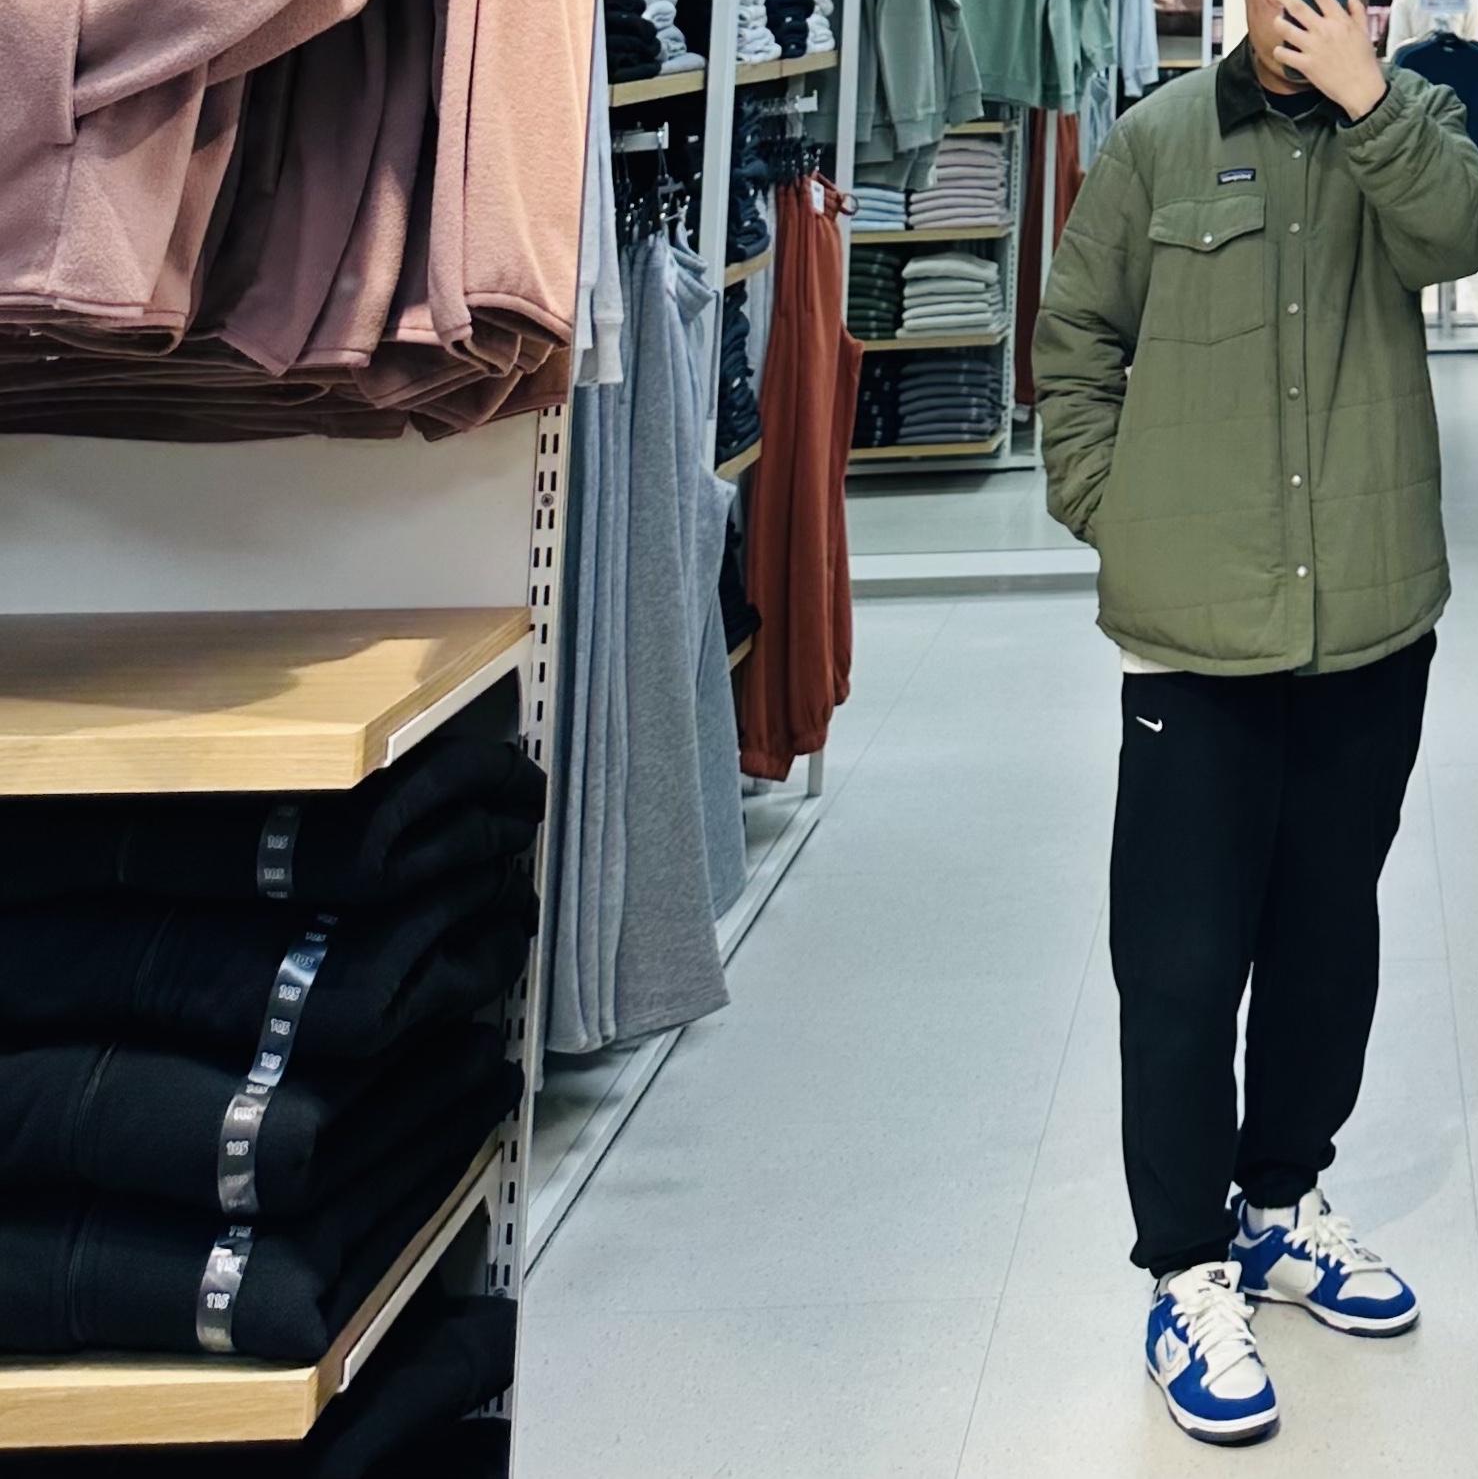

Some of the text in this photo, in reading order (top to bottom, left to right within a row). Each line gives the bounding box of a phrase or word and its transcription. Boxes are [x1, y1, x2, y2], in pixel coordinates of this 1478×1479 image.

[278, 984, 301, 1001] 105
[270, 1018, 291, 1035] 105
[226, 1140, 249, 1156] 105
[206, 1292, 230, 1310] 115
